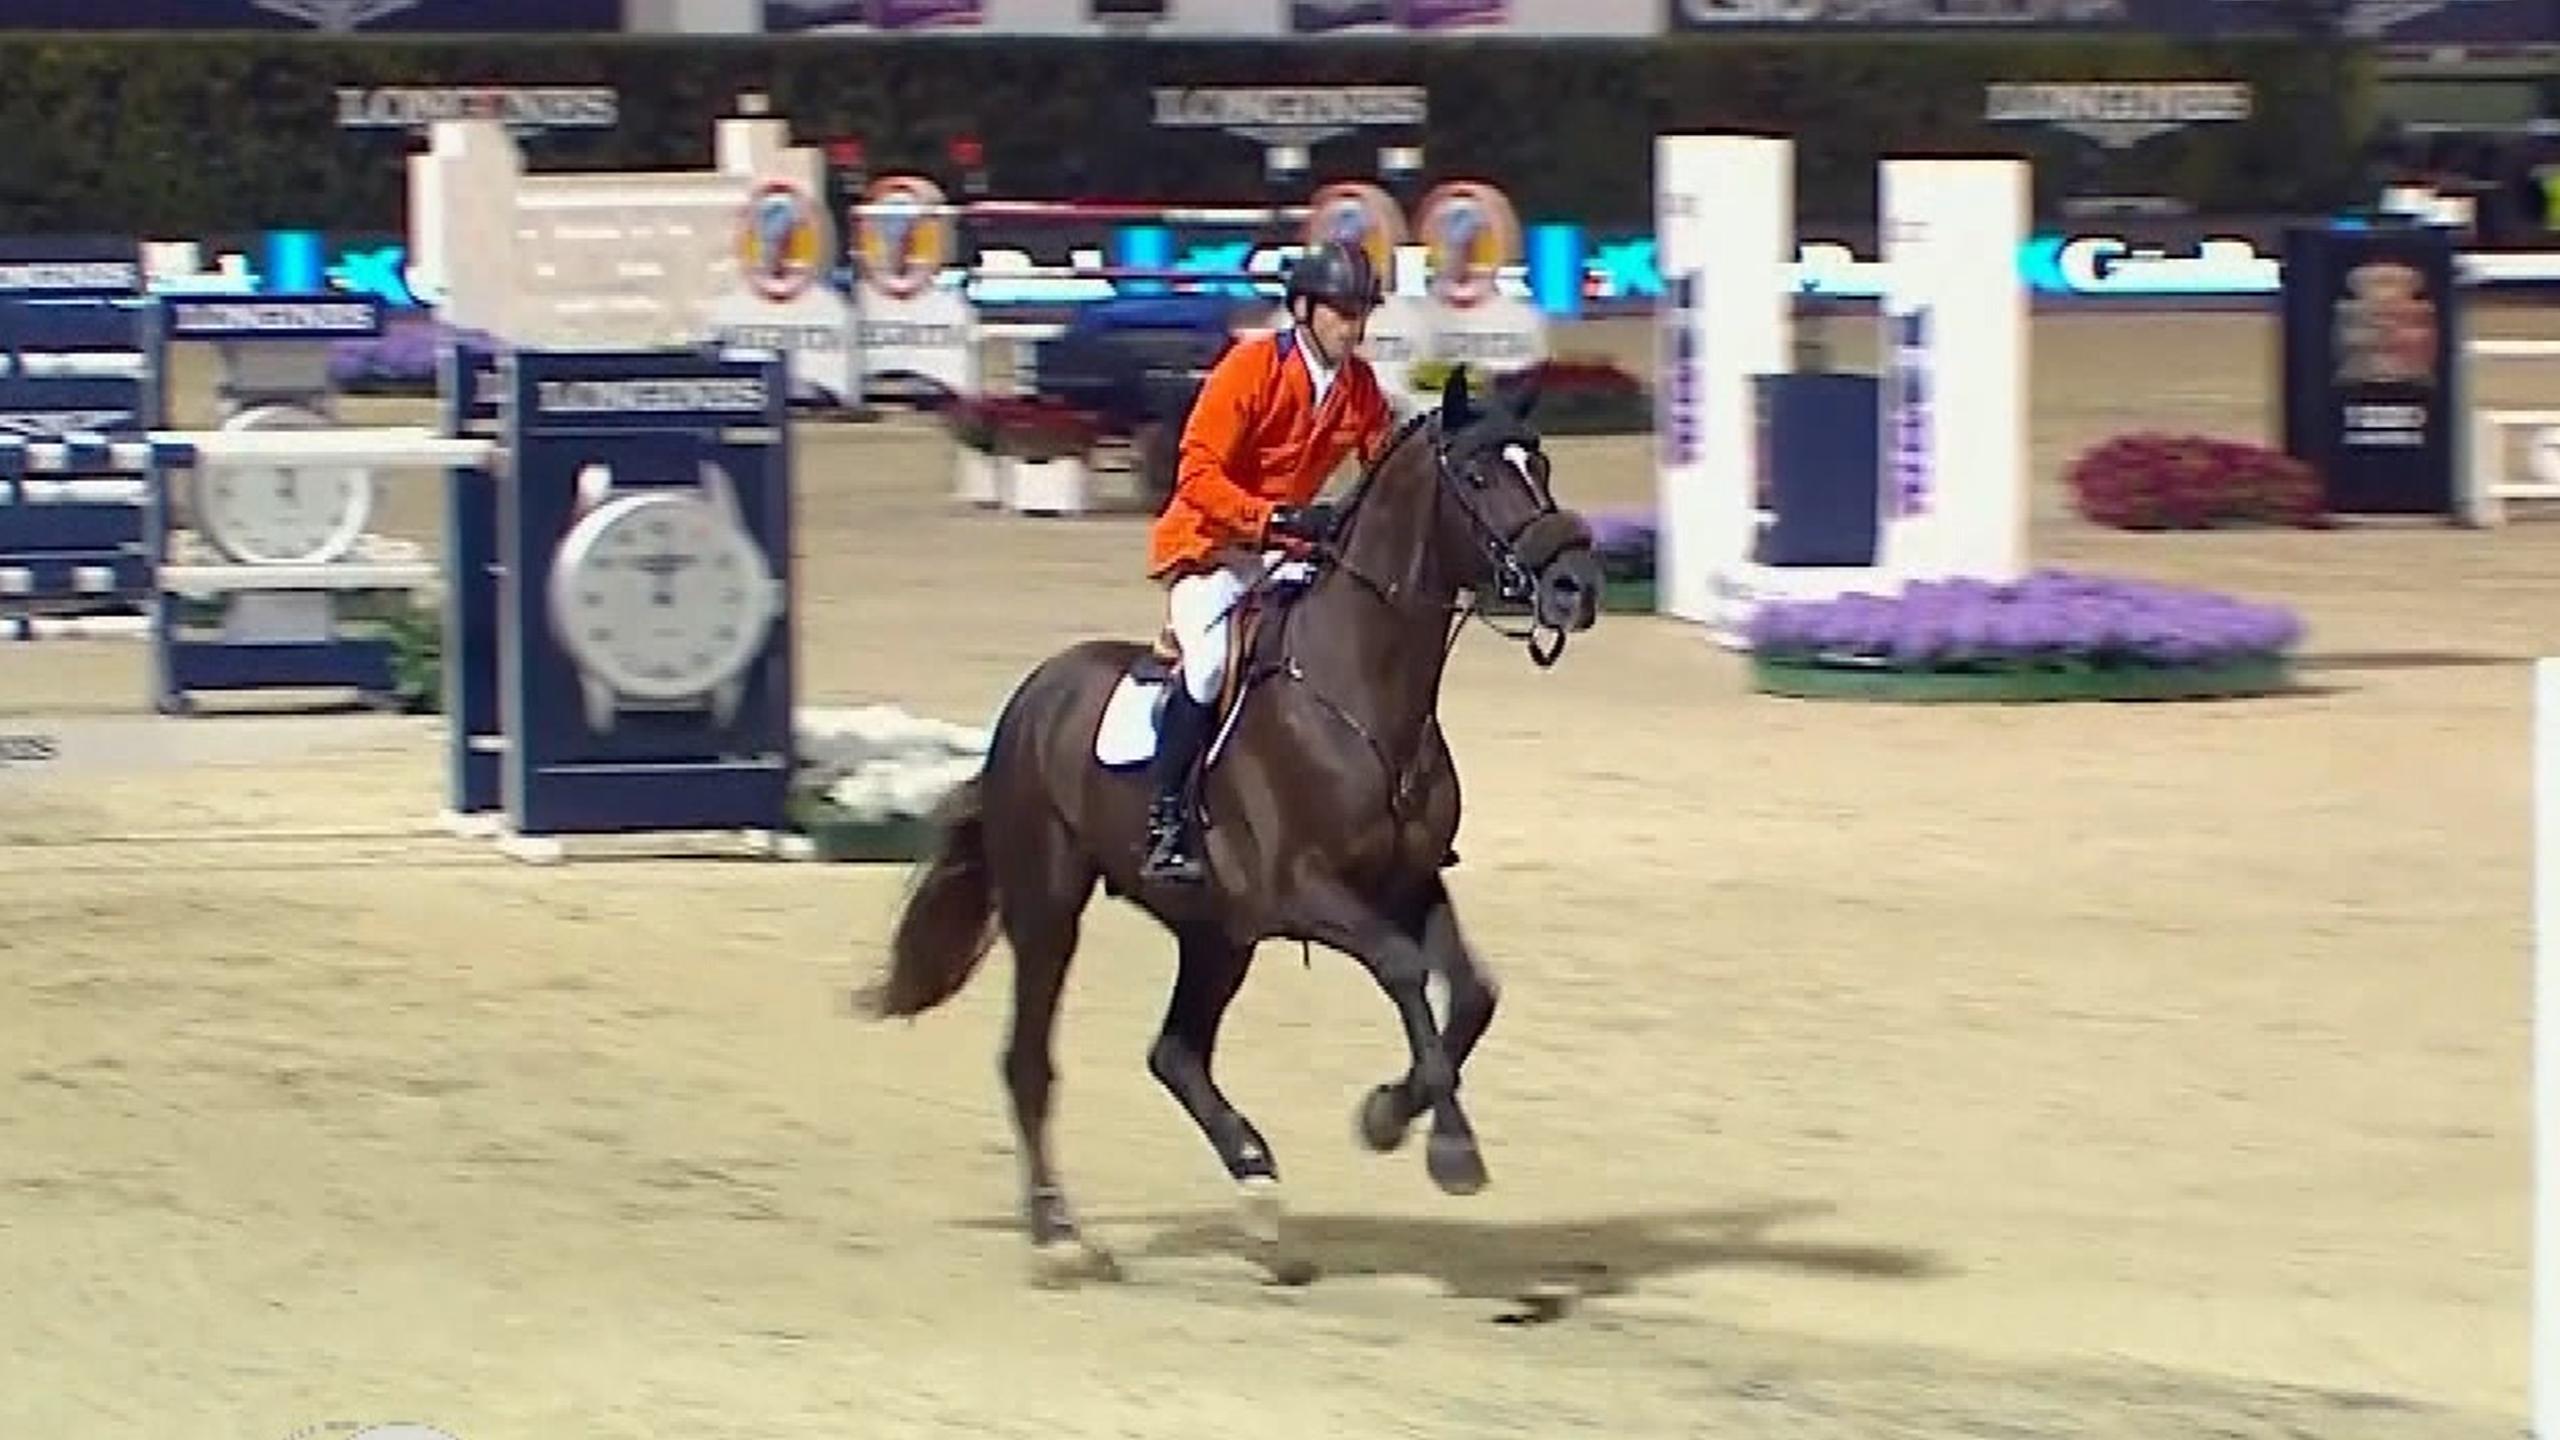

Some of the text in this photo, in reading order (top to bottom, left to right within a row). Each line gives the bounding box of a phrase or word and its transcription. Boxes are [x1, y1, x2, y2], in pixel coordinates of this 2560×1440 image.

[335, 86, 619, 126] LONGINES
[1152, 86, 1427, 125] LONGINES
[1984, 82, 2252, 120] LONGINES
[174, 301, 376, 331] LONGINES
[536, 377, 767, 413] LONGINES
